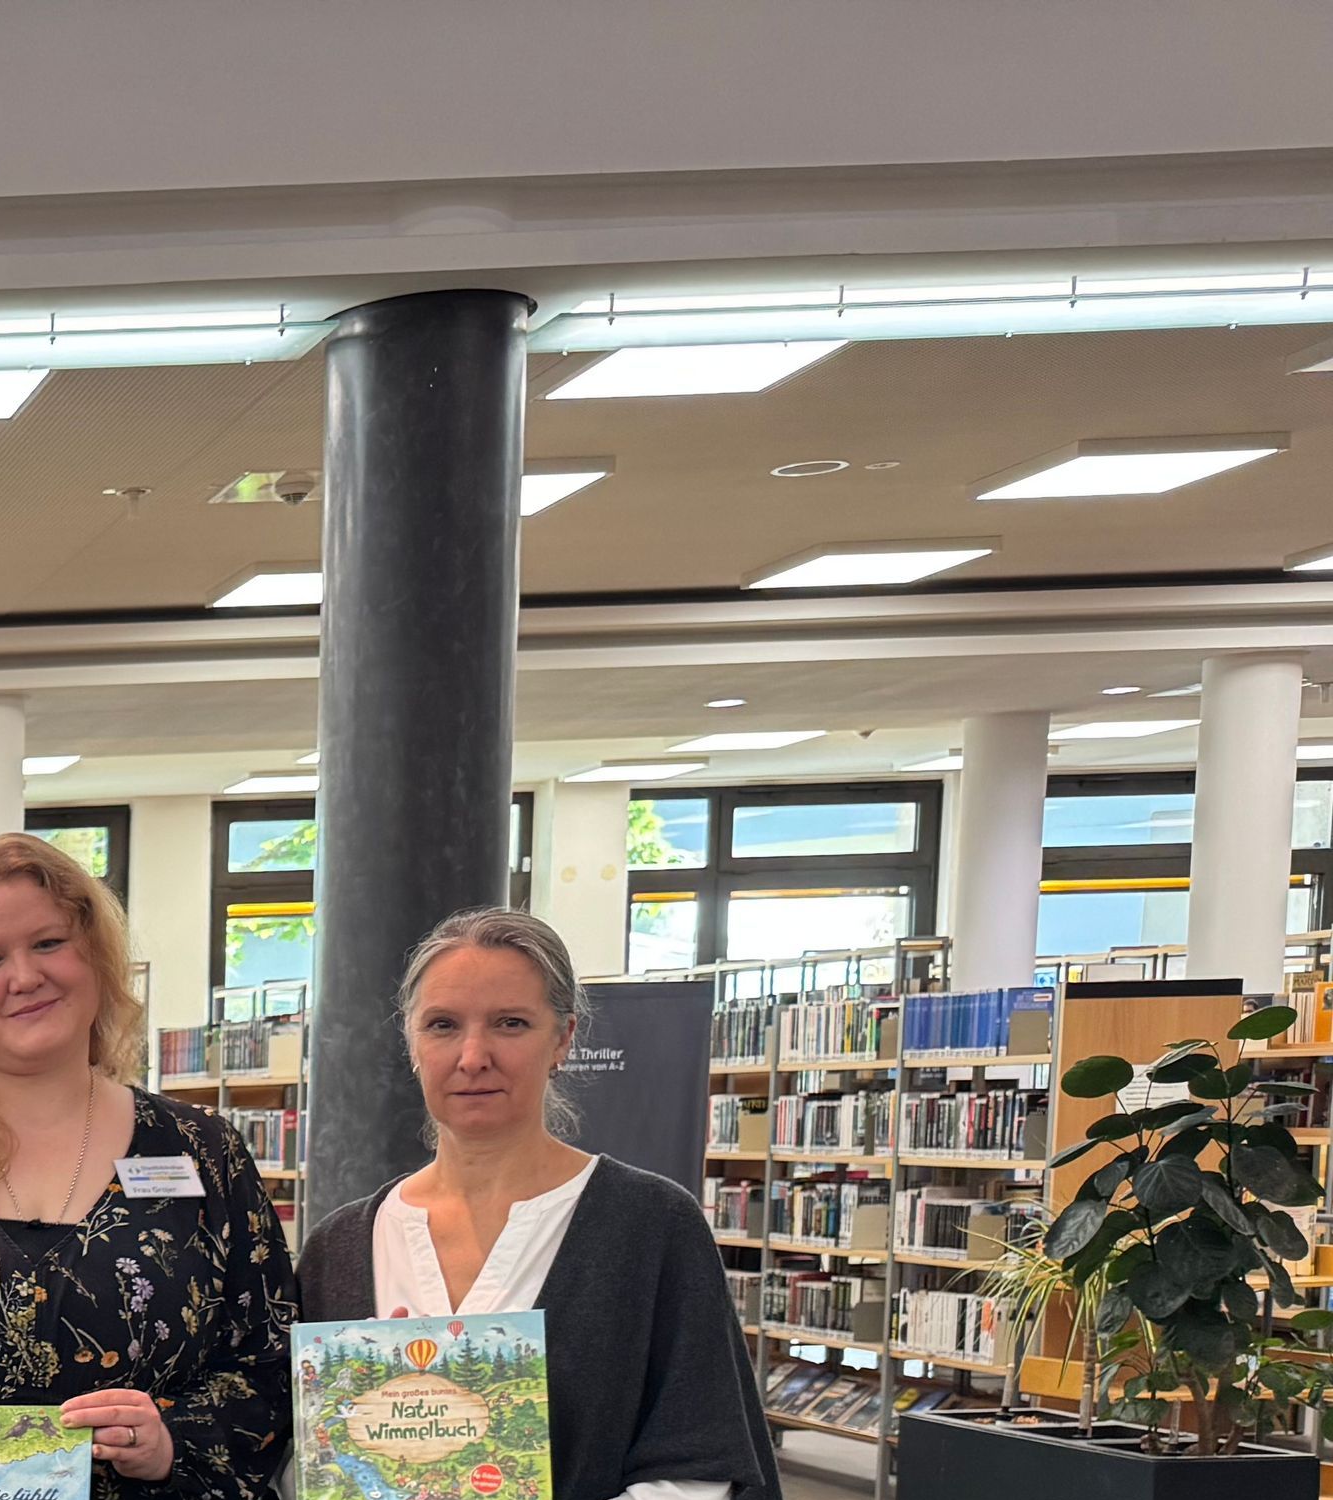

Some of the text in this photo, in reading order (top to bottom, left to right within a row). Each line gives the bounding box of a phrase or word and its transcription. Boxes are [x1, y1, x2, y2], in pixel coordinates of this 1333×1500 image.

[581, 1048, 623, 1060] Thriller
[392, 1399, 448, 1418] Natur
[365, 1418, 477, 1441] Wimmelbuch
